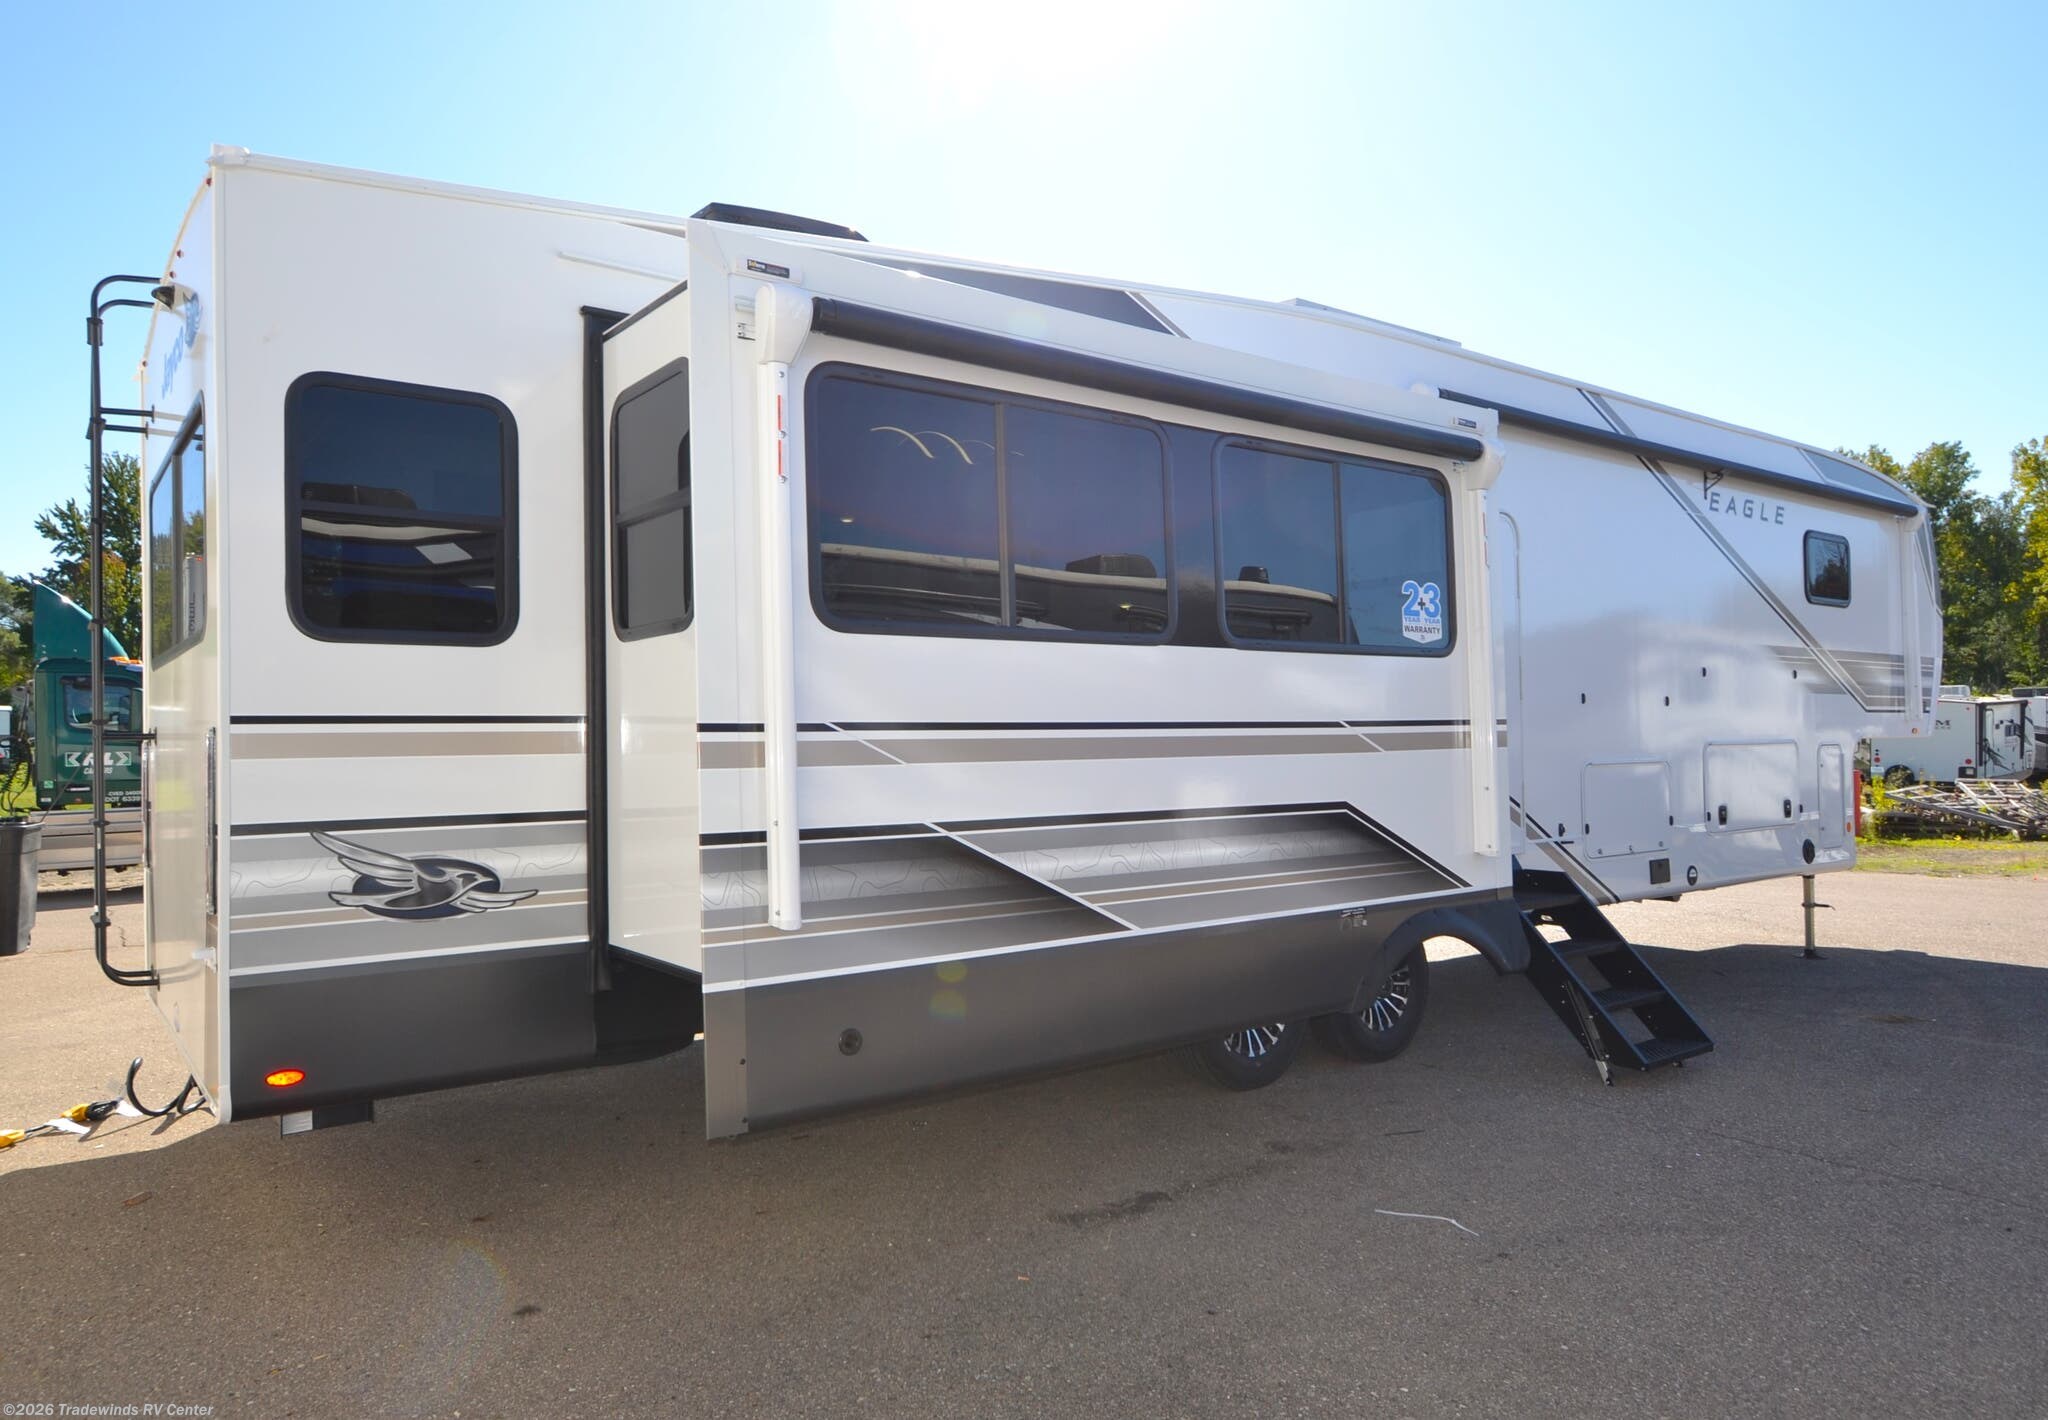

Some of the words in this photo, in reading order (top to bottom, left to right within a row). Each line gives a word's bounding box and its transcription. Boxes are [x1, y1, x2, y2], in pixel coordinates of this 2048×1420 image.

[161, 326, 184, 400] Jayco
[1708, 491, 1785, 525] EAGLE
[1404, 625, 1441, 635] WARRANTY
